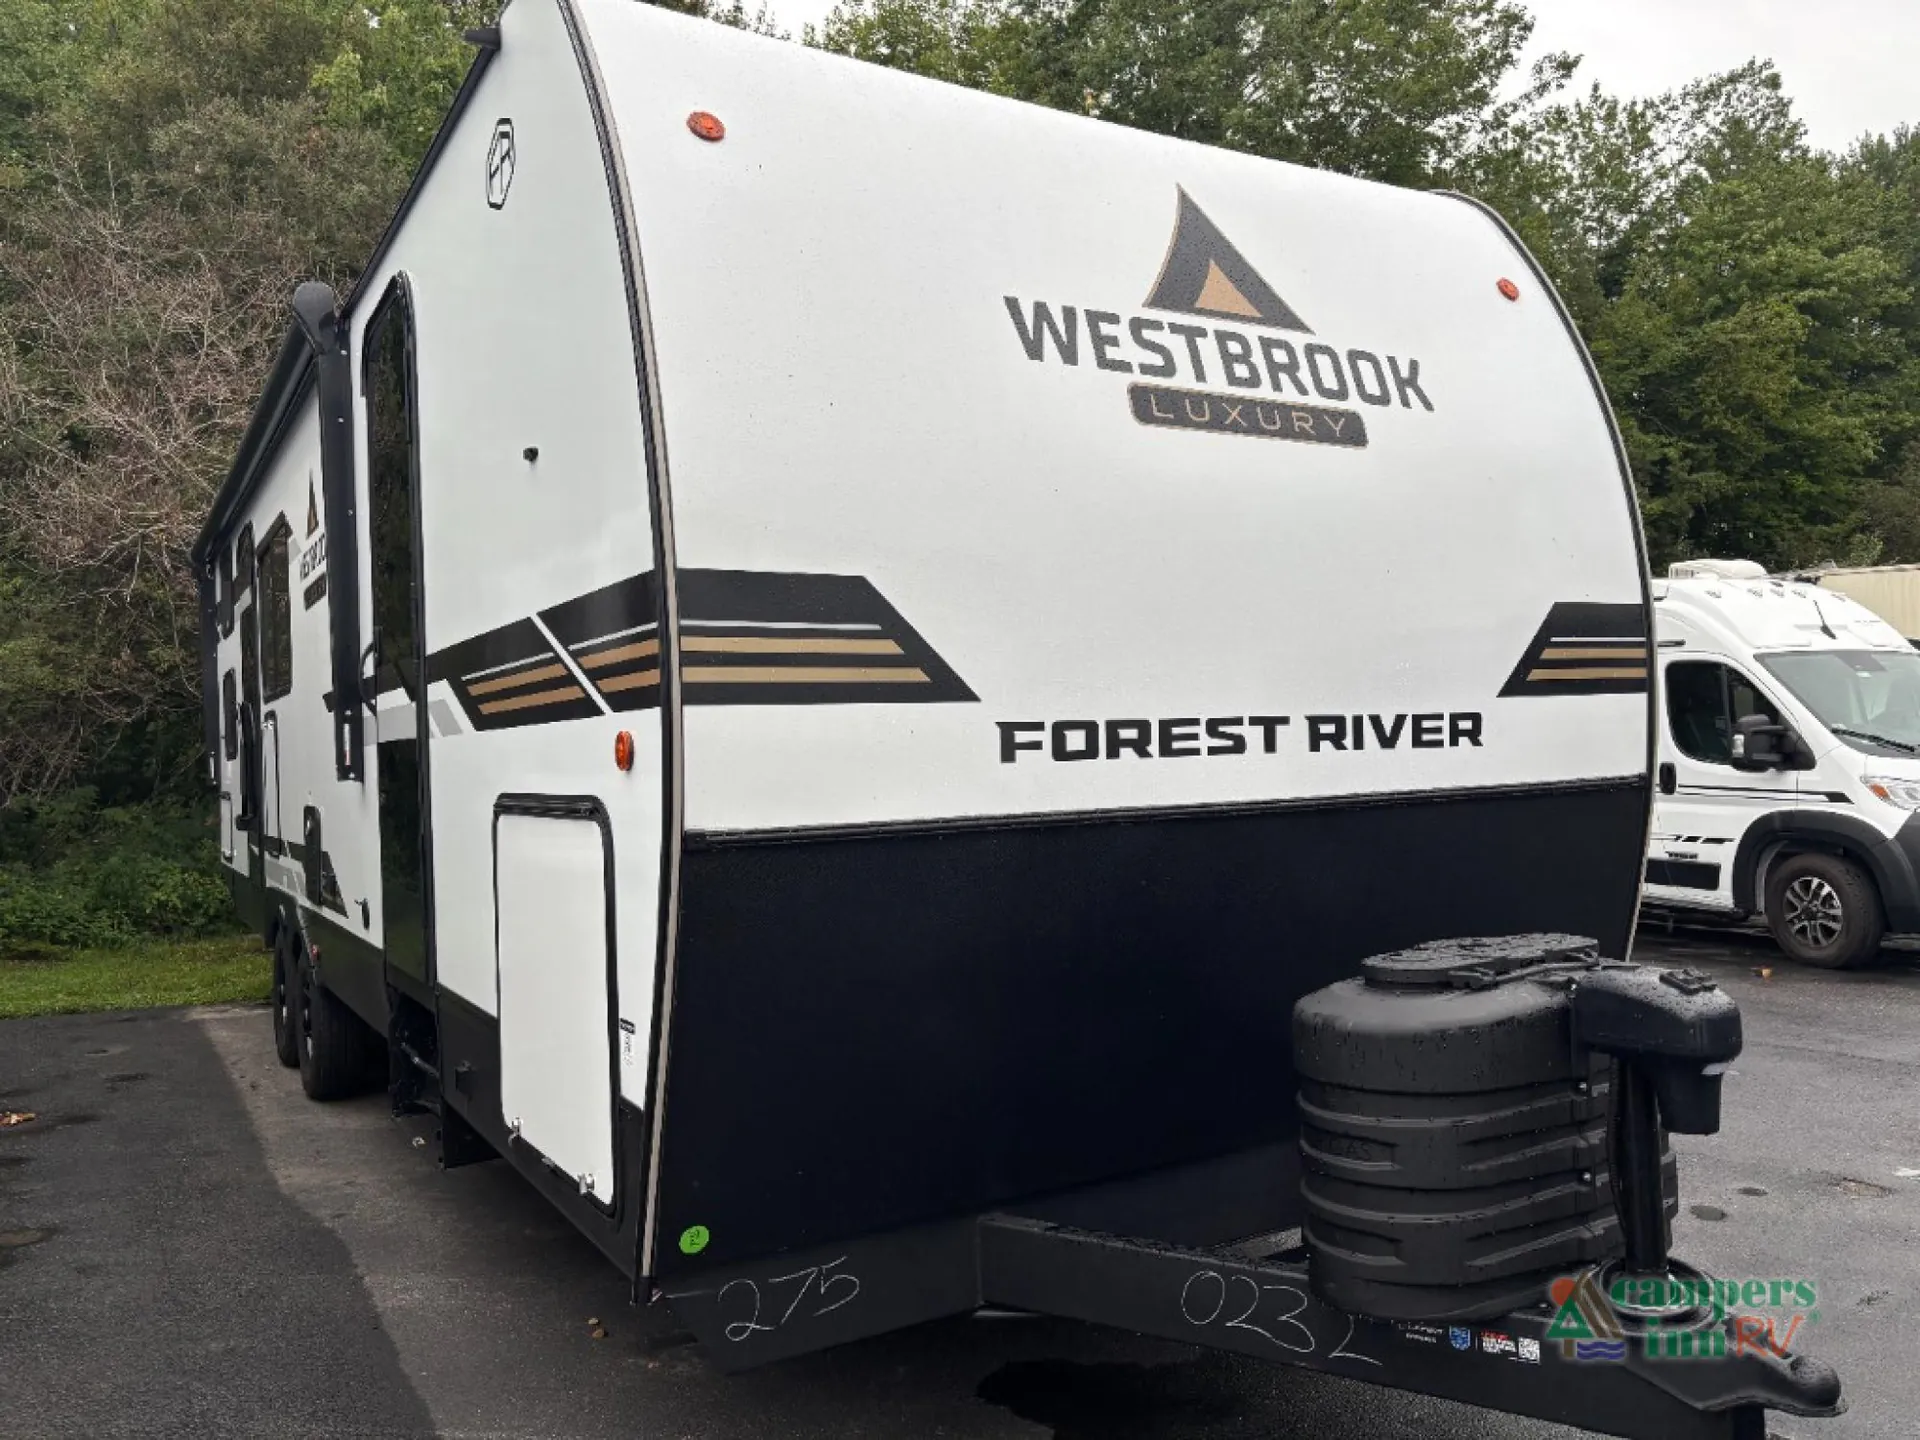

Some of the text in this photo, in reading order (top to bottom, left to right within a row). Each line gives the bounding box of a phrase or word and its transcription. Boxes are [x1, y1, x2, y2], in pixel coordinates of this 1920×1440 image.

[1003, 296, 1435, 412] WESTBROOK
[1149, 393, 1346, 438] LUXURY
[995, 711, 1484, 764] FOREST RIVER
[717, 1256, 860, 1341] 275
